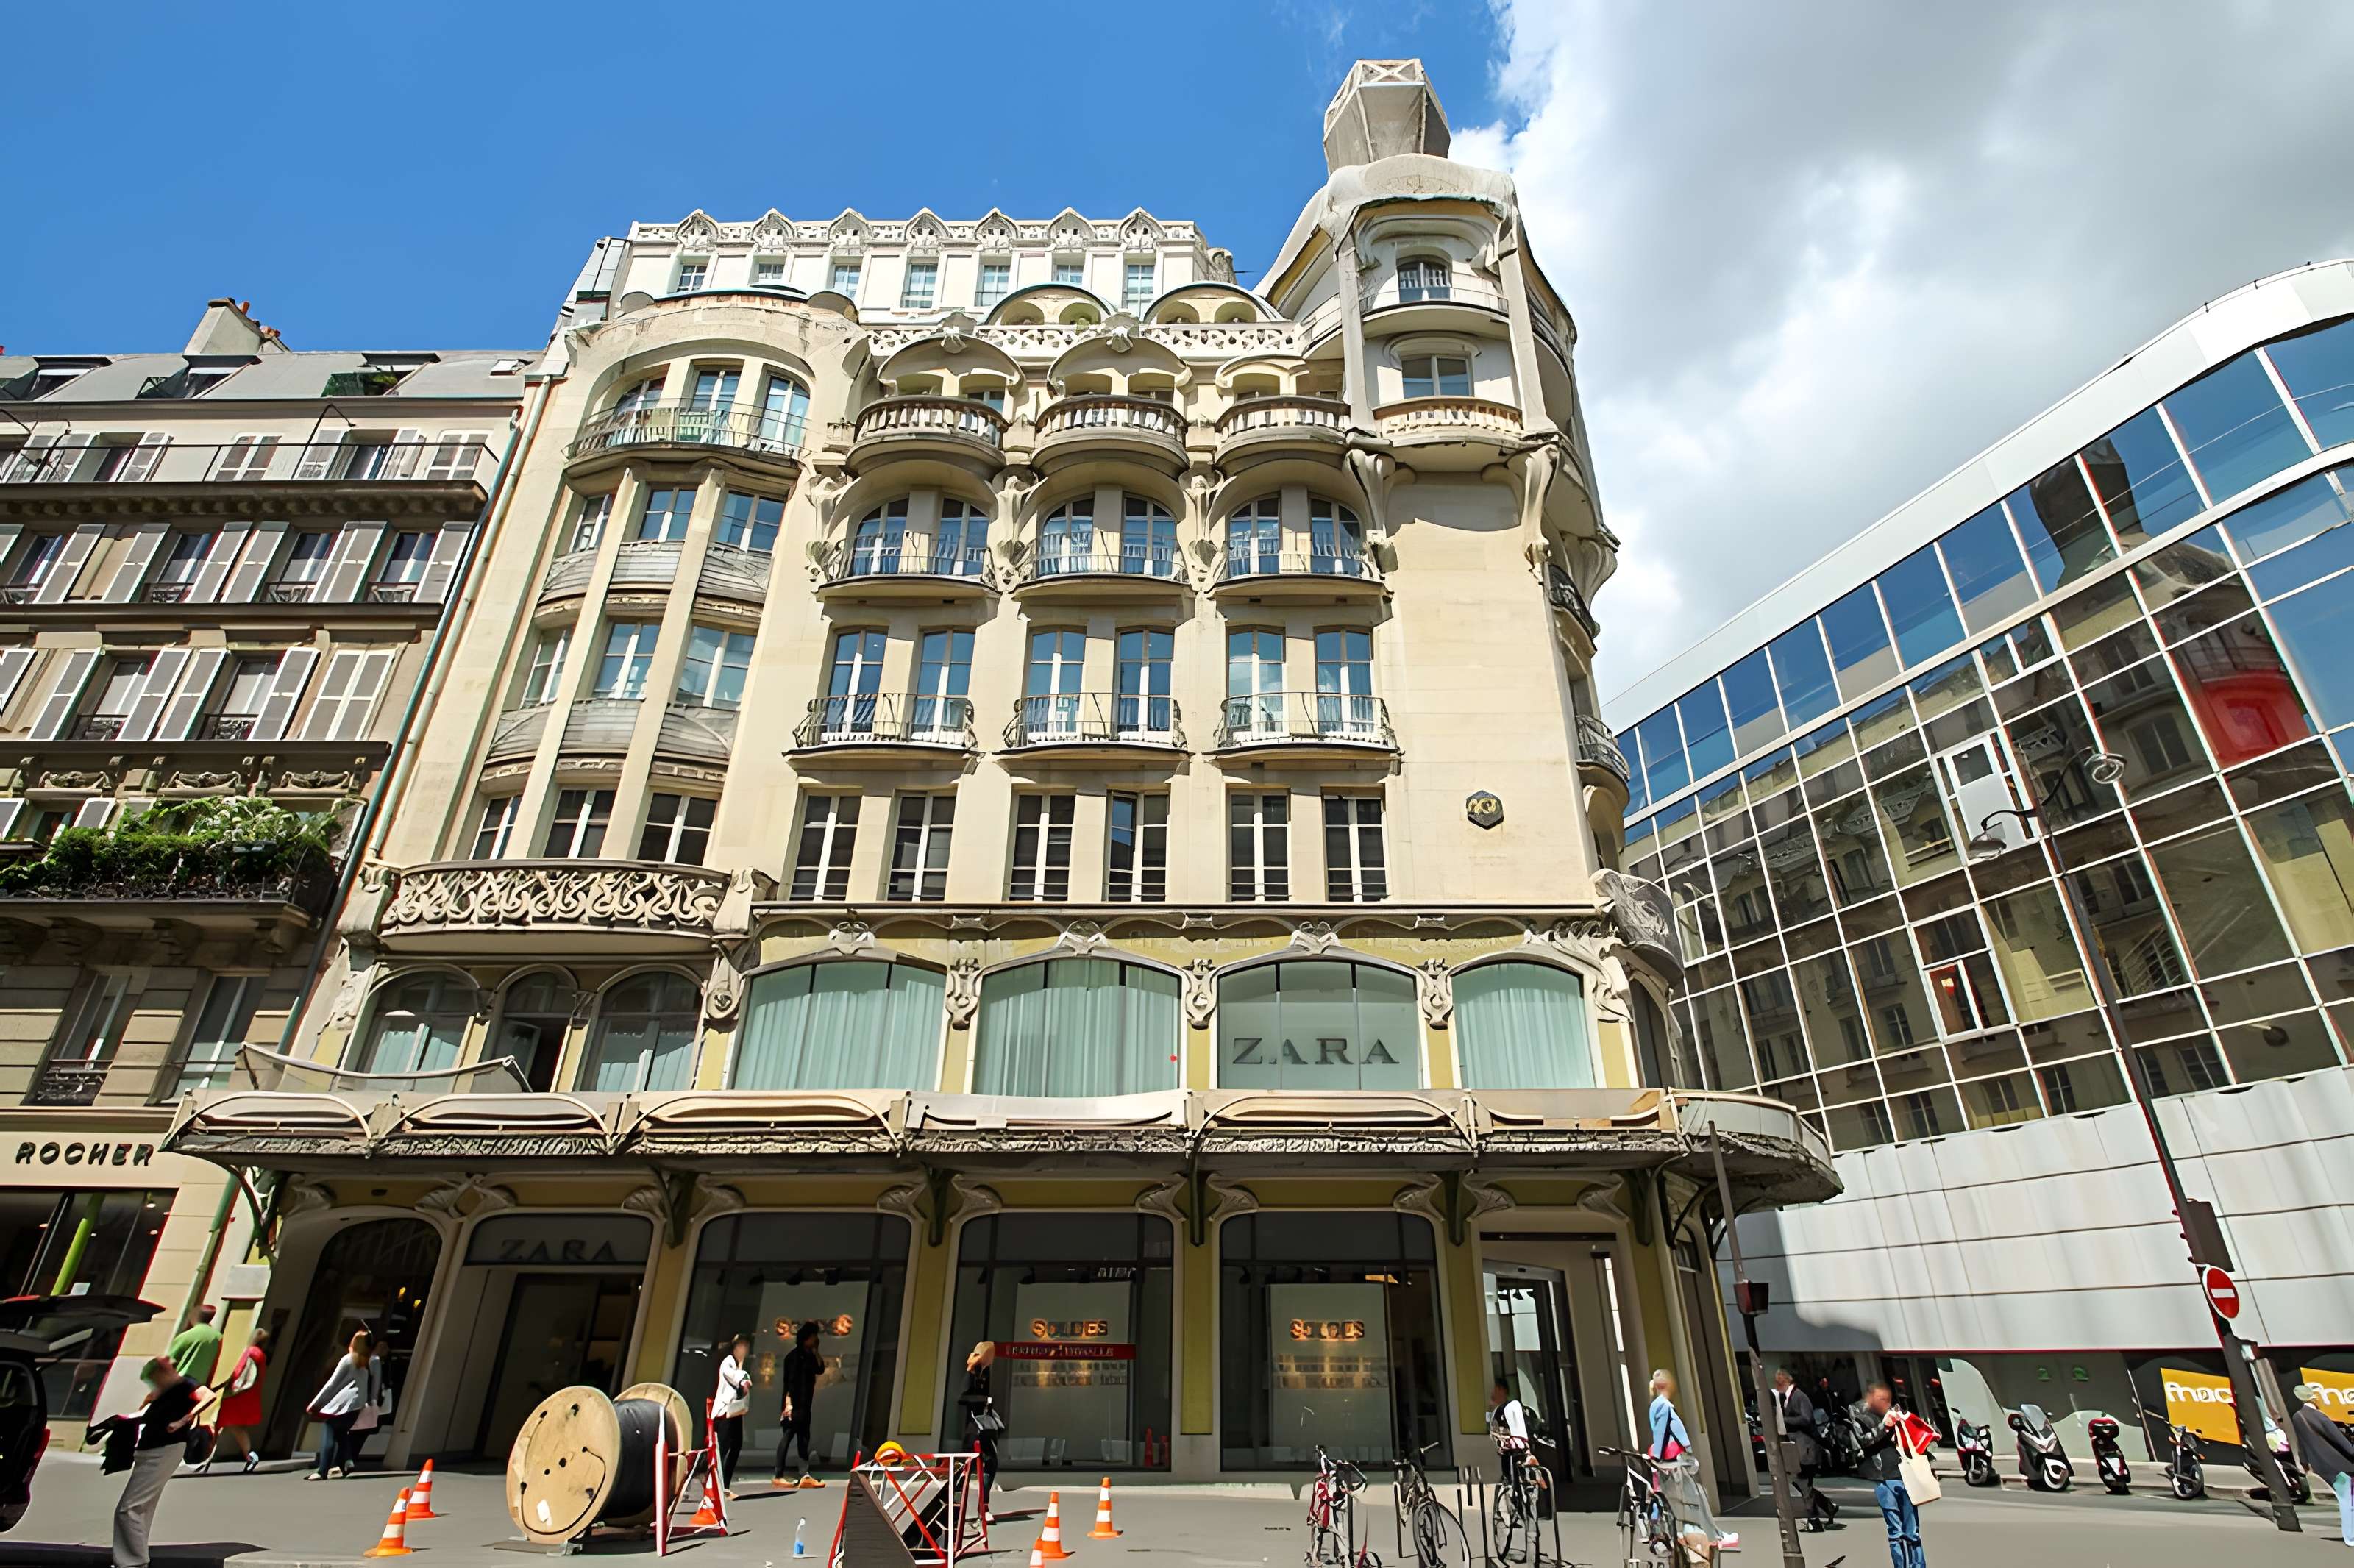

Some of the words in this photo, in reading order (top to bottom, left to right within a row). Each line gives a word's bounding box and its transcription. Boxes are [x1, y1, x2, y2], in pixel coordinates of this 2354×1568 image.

[1232, 1038, 1400, 1064] ZARA
[15, 1141, 154, 1166] ROCHER
[499, 1239, 618, 1261] ZARA
[2165, 1381, 2235, 1403] fnac
